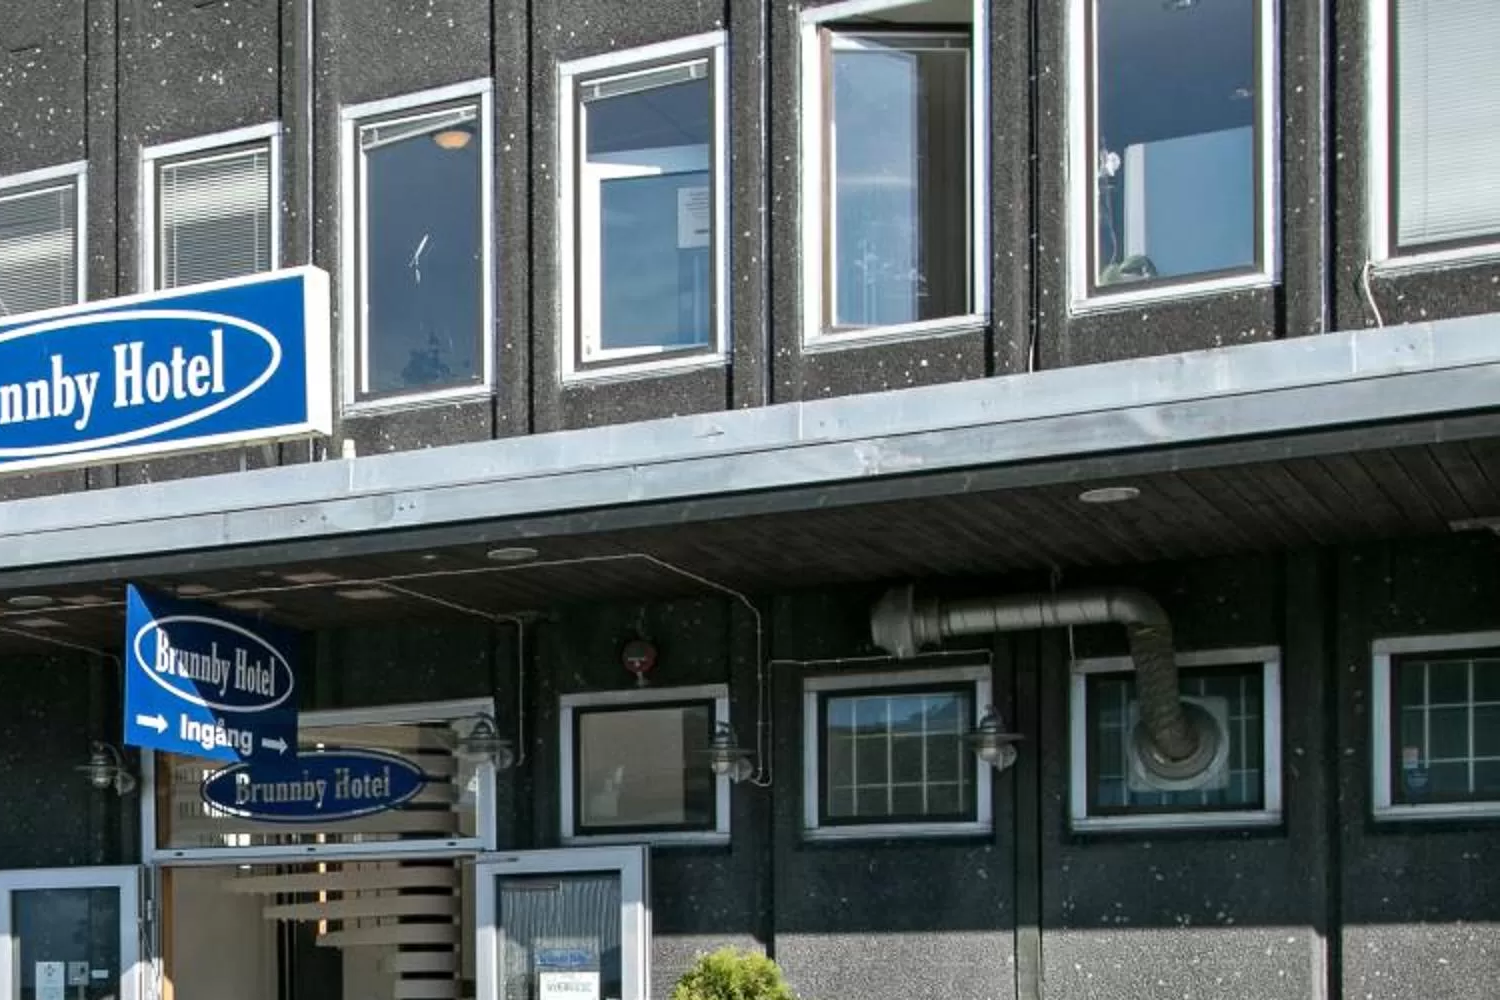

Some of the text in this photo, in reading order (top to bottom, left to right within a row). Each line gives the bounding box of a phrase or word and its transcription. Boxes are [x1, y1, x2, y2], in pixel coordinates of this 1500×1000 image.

[113, 328, 225, 407] Hotel
[155, 627, 276, 697] Brunnby Hotel
[180, 713, 252, 755] Ingång
[235, 766, 391, 808] Brunnby Hotel
